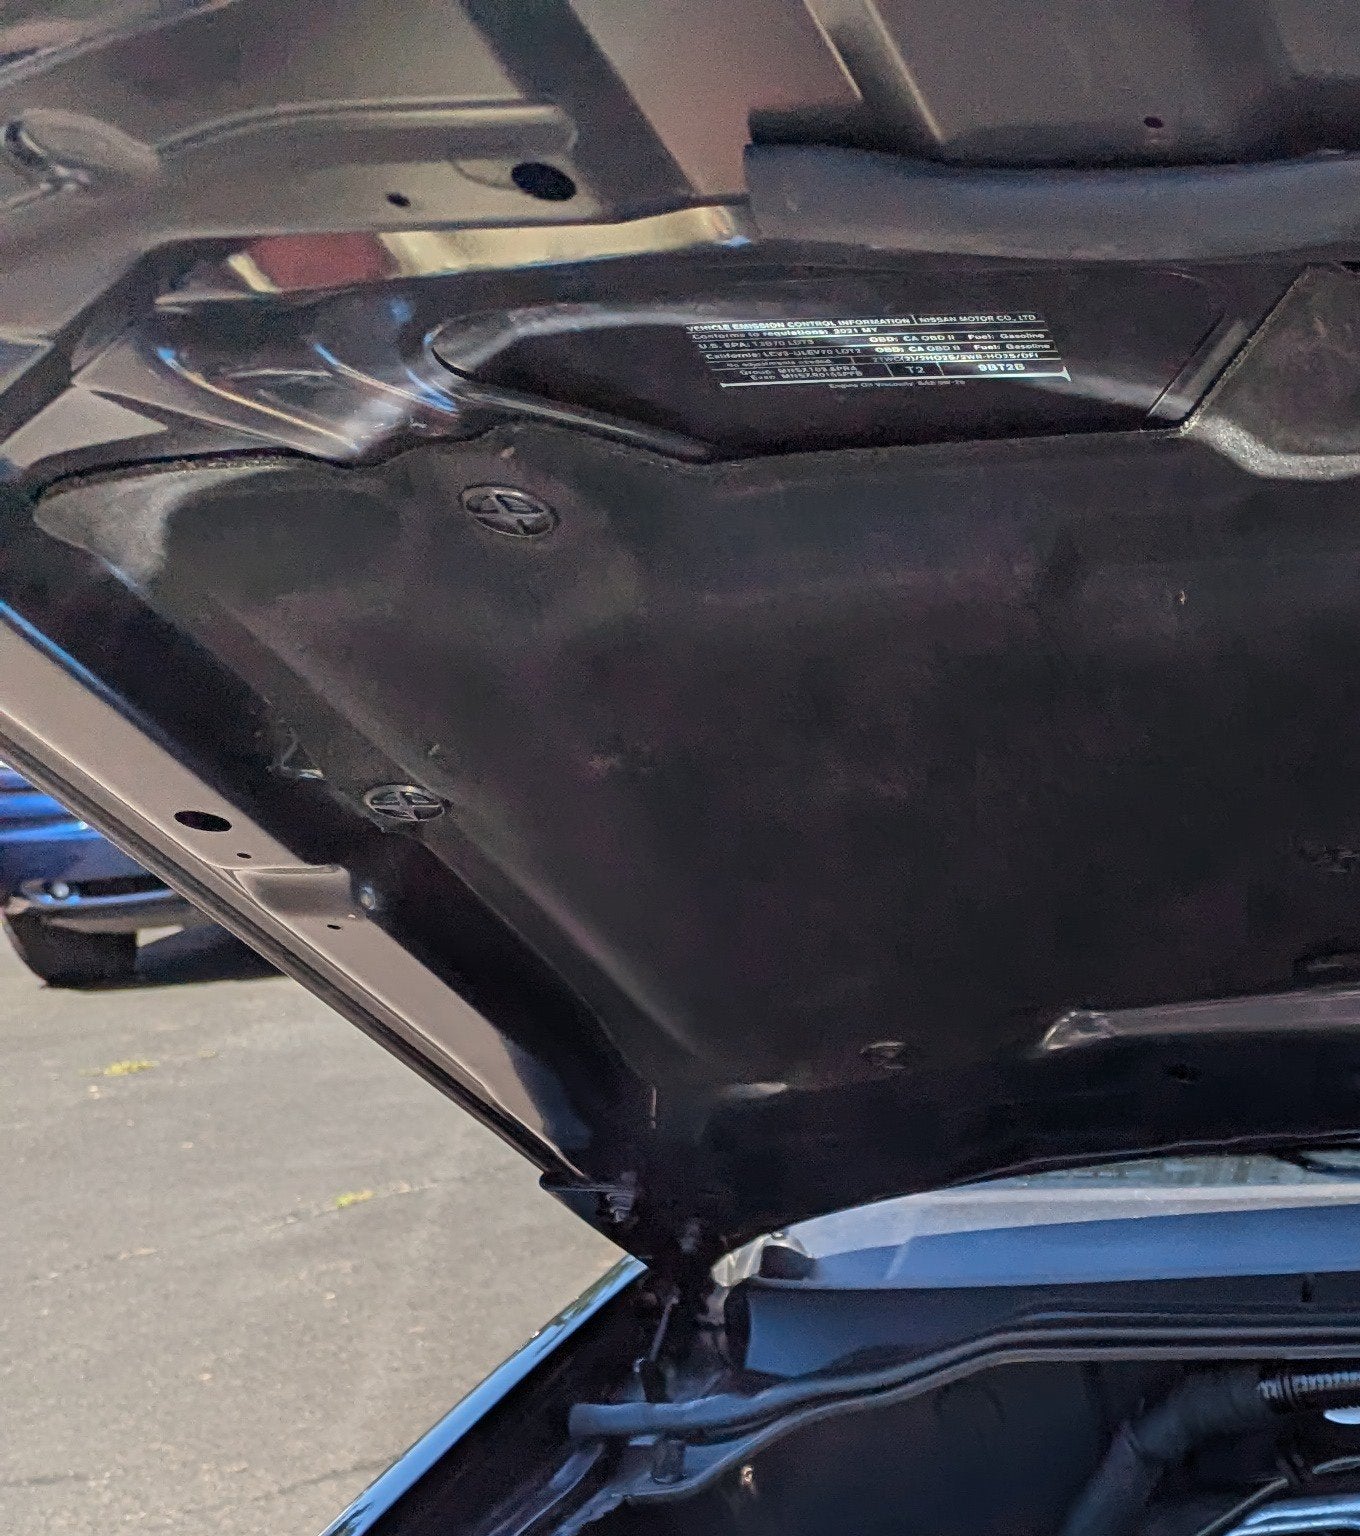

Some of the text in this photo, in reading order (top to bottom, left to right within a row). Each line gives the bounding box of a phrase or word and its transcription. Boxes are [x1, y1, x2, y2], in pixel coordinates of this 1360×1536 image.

[918, 316, 957, 324] NISSAN
[960, 315, 994, 323] MOTOR
[686, 318, 910, 332] VEHICLE EMISSION CONTROL INFORMATION
[905, 365, 925, 374] T2
